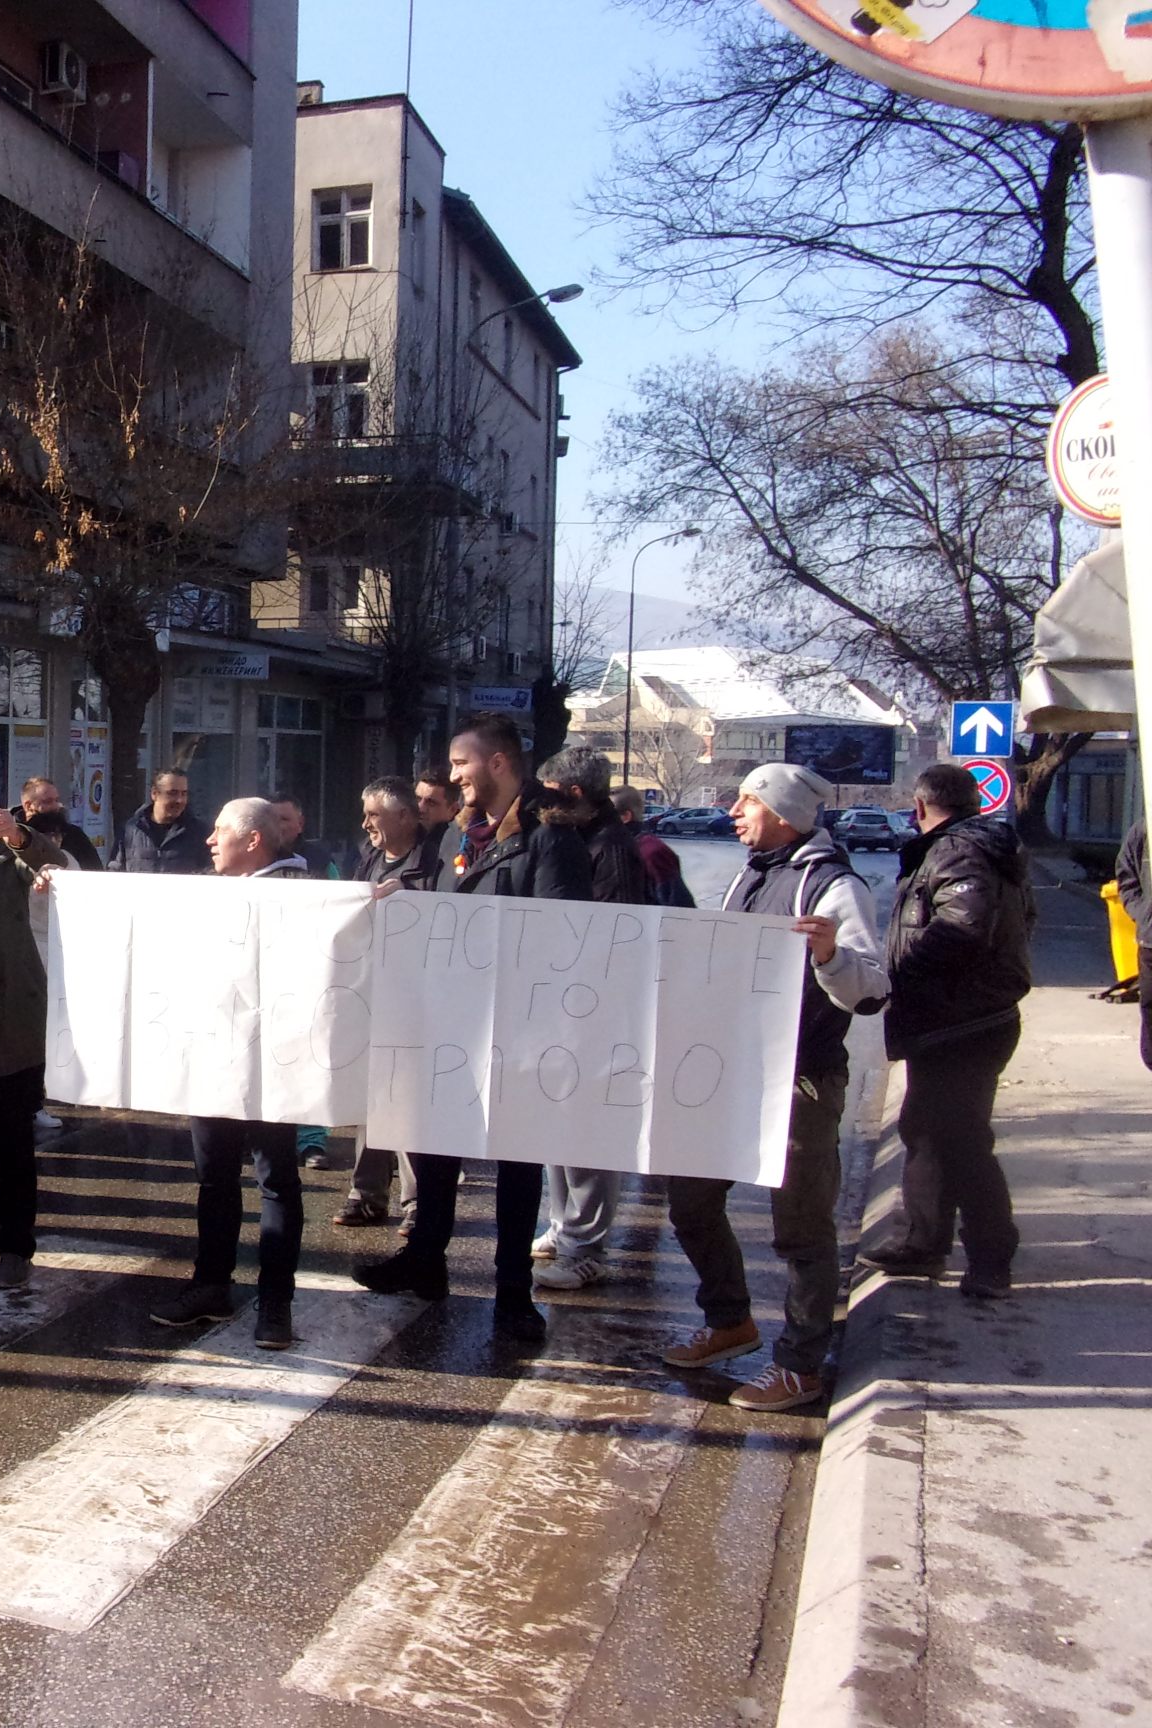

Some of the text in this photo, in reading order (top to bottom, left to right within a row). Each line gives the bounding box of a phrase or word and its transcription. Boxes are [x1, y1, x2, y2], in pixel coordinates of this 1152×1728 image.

[382, 899, 786, 994] РАСТУРЕТЕ
[527, 982, 600, 1021] ГО
[371, 1042, 725, 1108] ТРЛОВО
